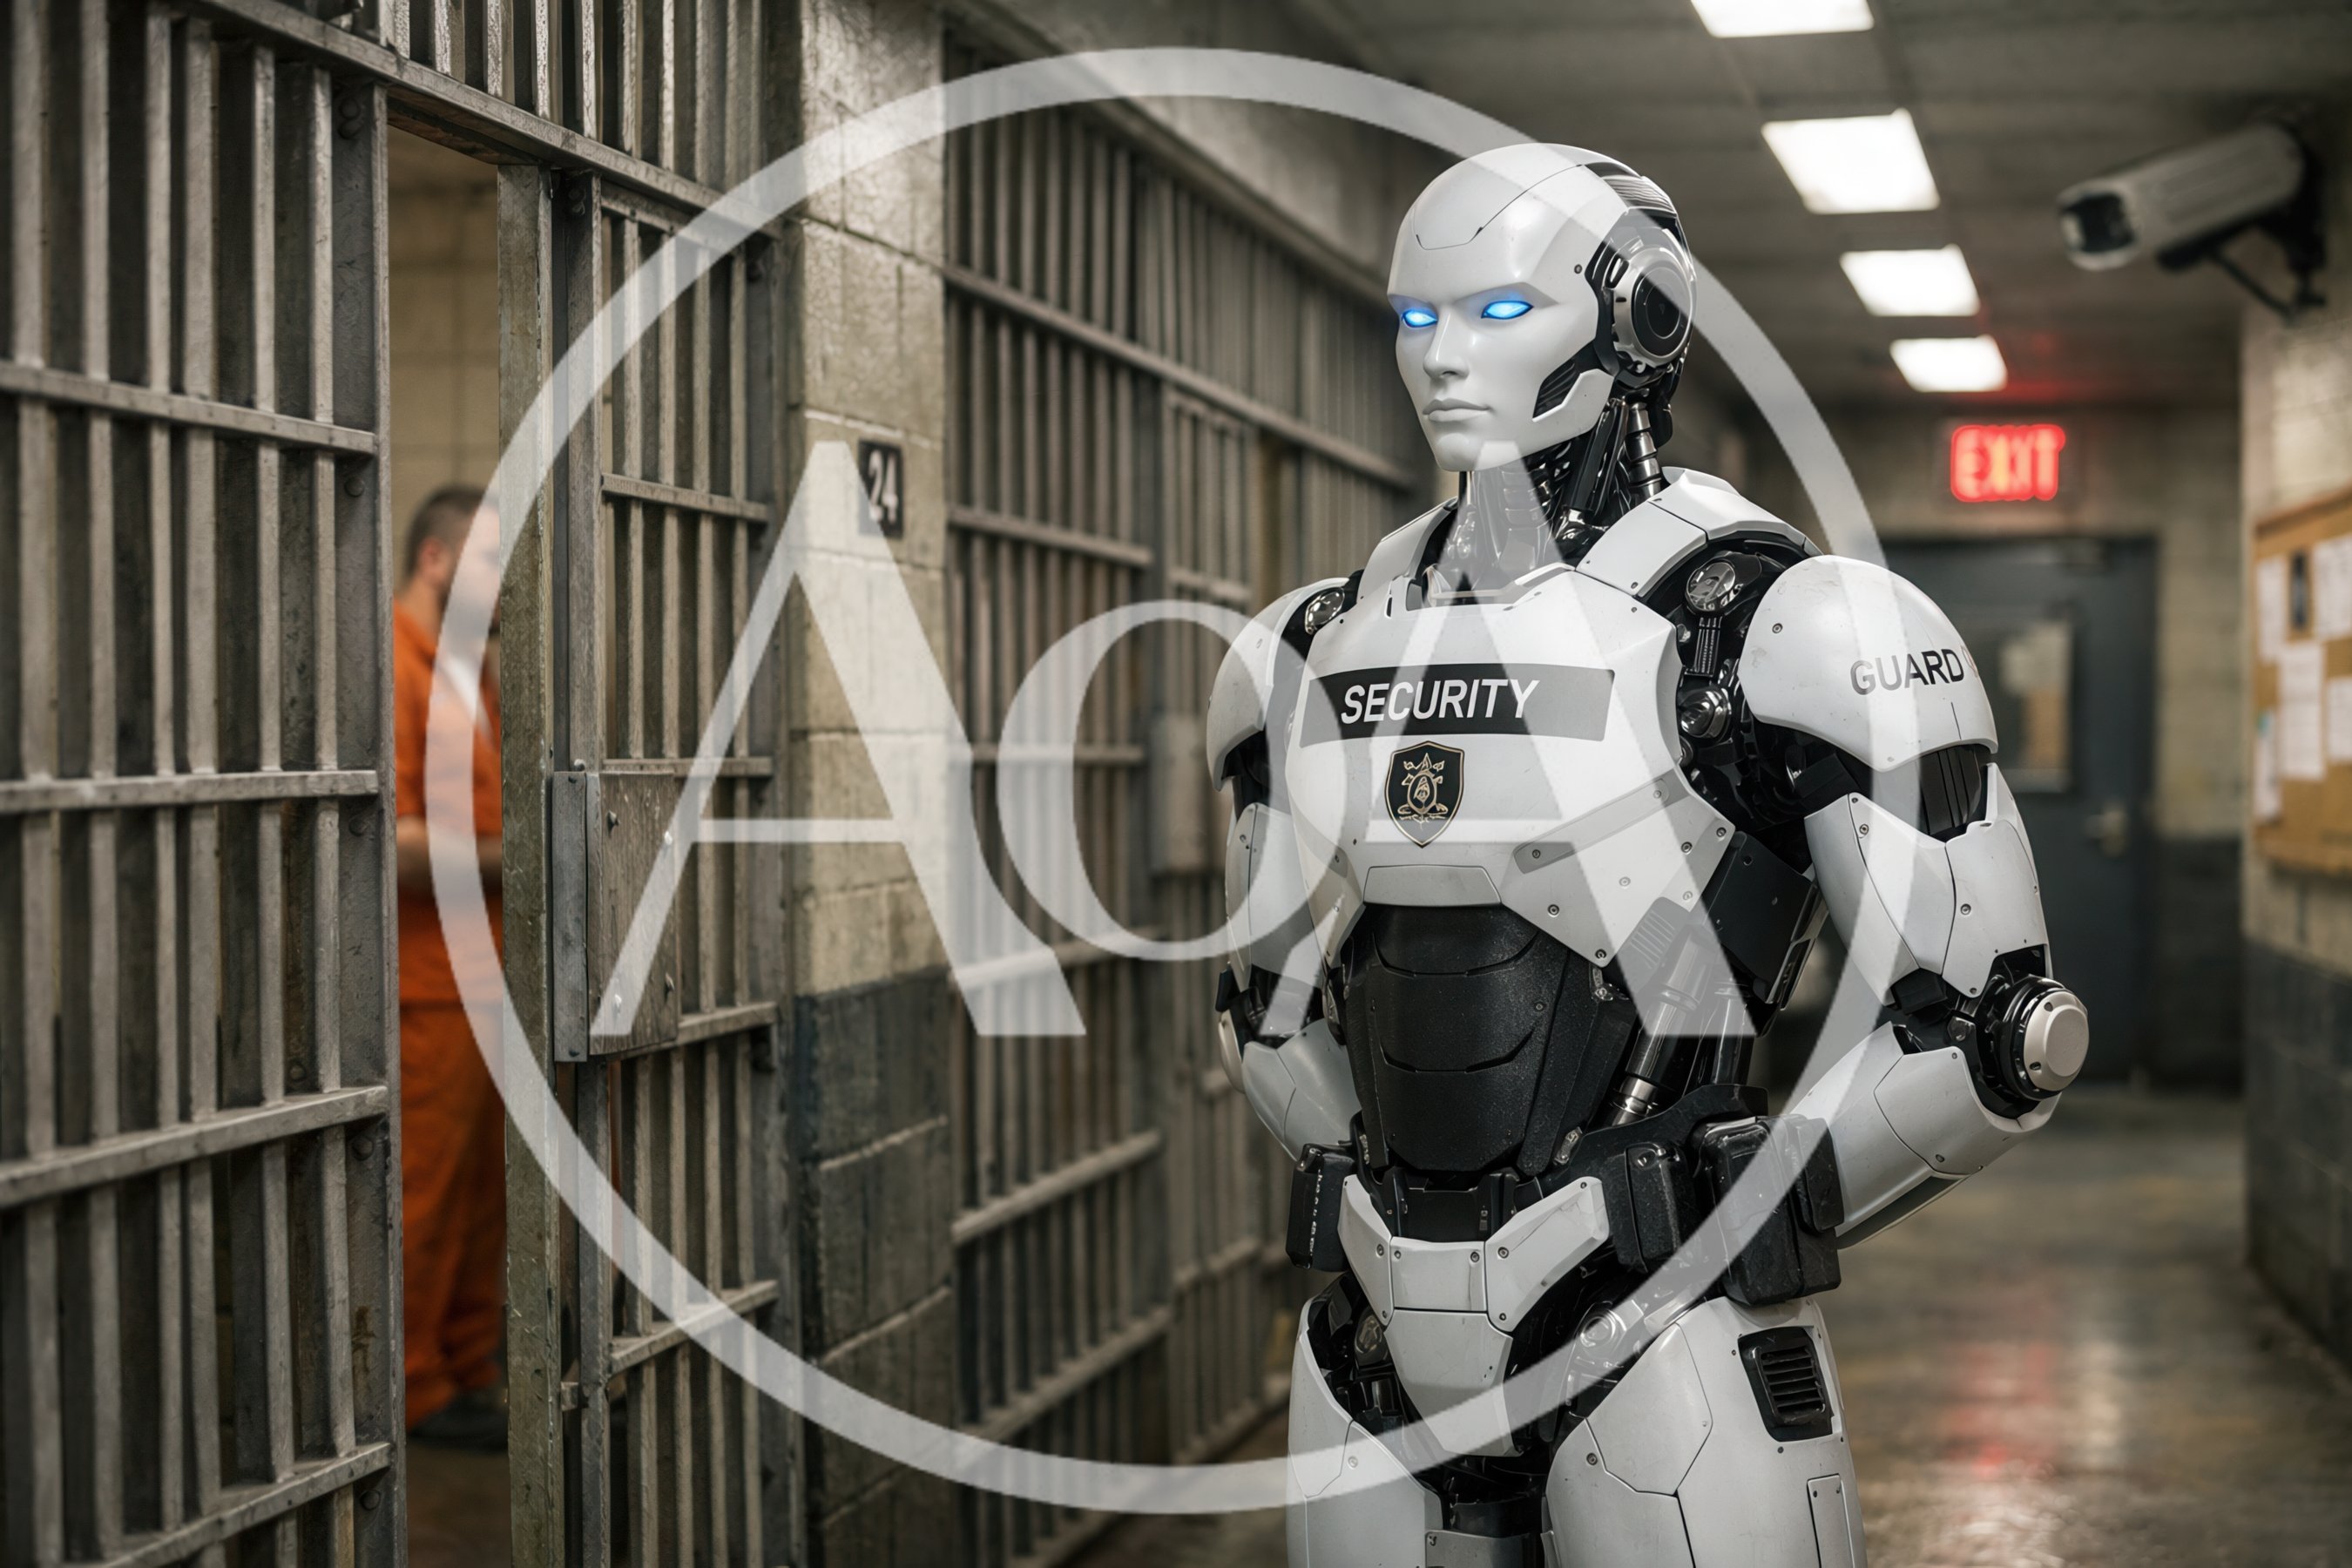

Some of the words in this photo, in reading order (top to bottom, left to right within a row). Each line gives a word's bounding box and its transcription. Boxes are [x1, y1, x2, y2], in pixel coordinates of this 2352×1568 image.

[868, 449, 898, 524] 24
[1951, 425, 2065, 501] EXIT
[1341, 679, 1540, 724] SECURITY
[1850, 649, 1964, 695] GUARD
